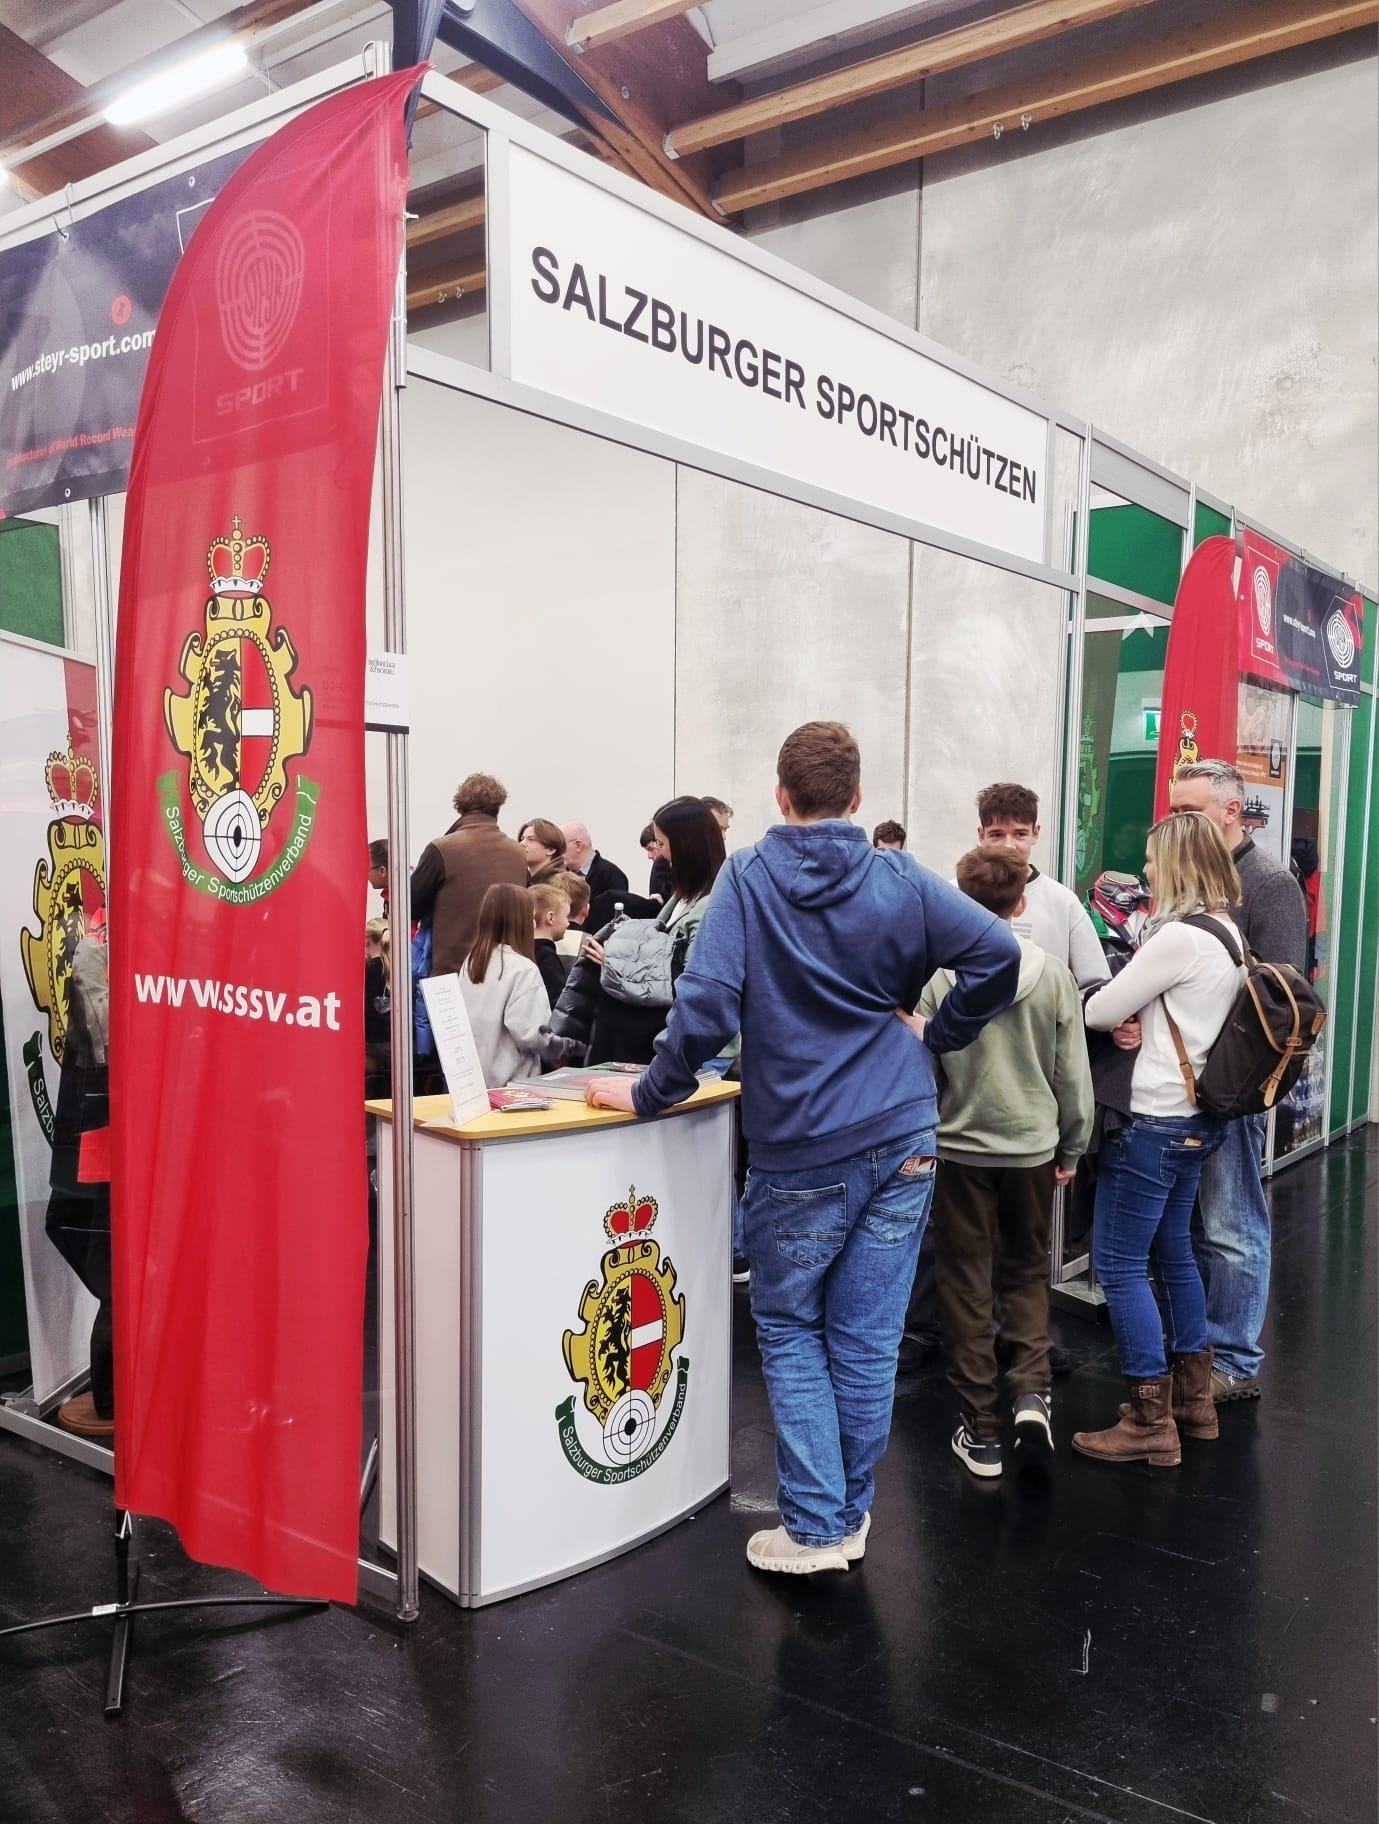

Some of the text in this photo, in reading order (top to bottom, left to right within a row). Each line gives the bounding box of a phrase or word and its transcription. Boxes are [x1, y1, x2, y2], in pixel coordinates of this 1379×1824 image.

[216, 367, 304, 415] SPORT
[531, 246, 1037, 504] SALZBURGER SPORTSCHÜTZEN
[80, 428, 111, 446] Record
[1334, 670, 1358, 684] SPORT
[207, 814, 312, 903] Sportschützenverband
[135, 973, 341, 1031] www.sssv.at
[563, 1383, 687, 1486] Salzburger Sportschützenverband
